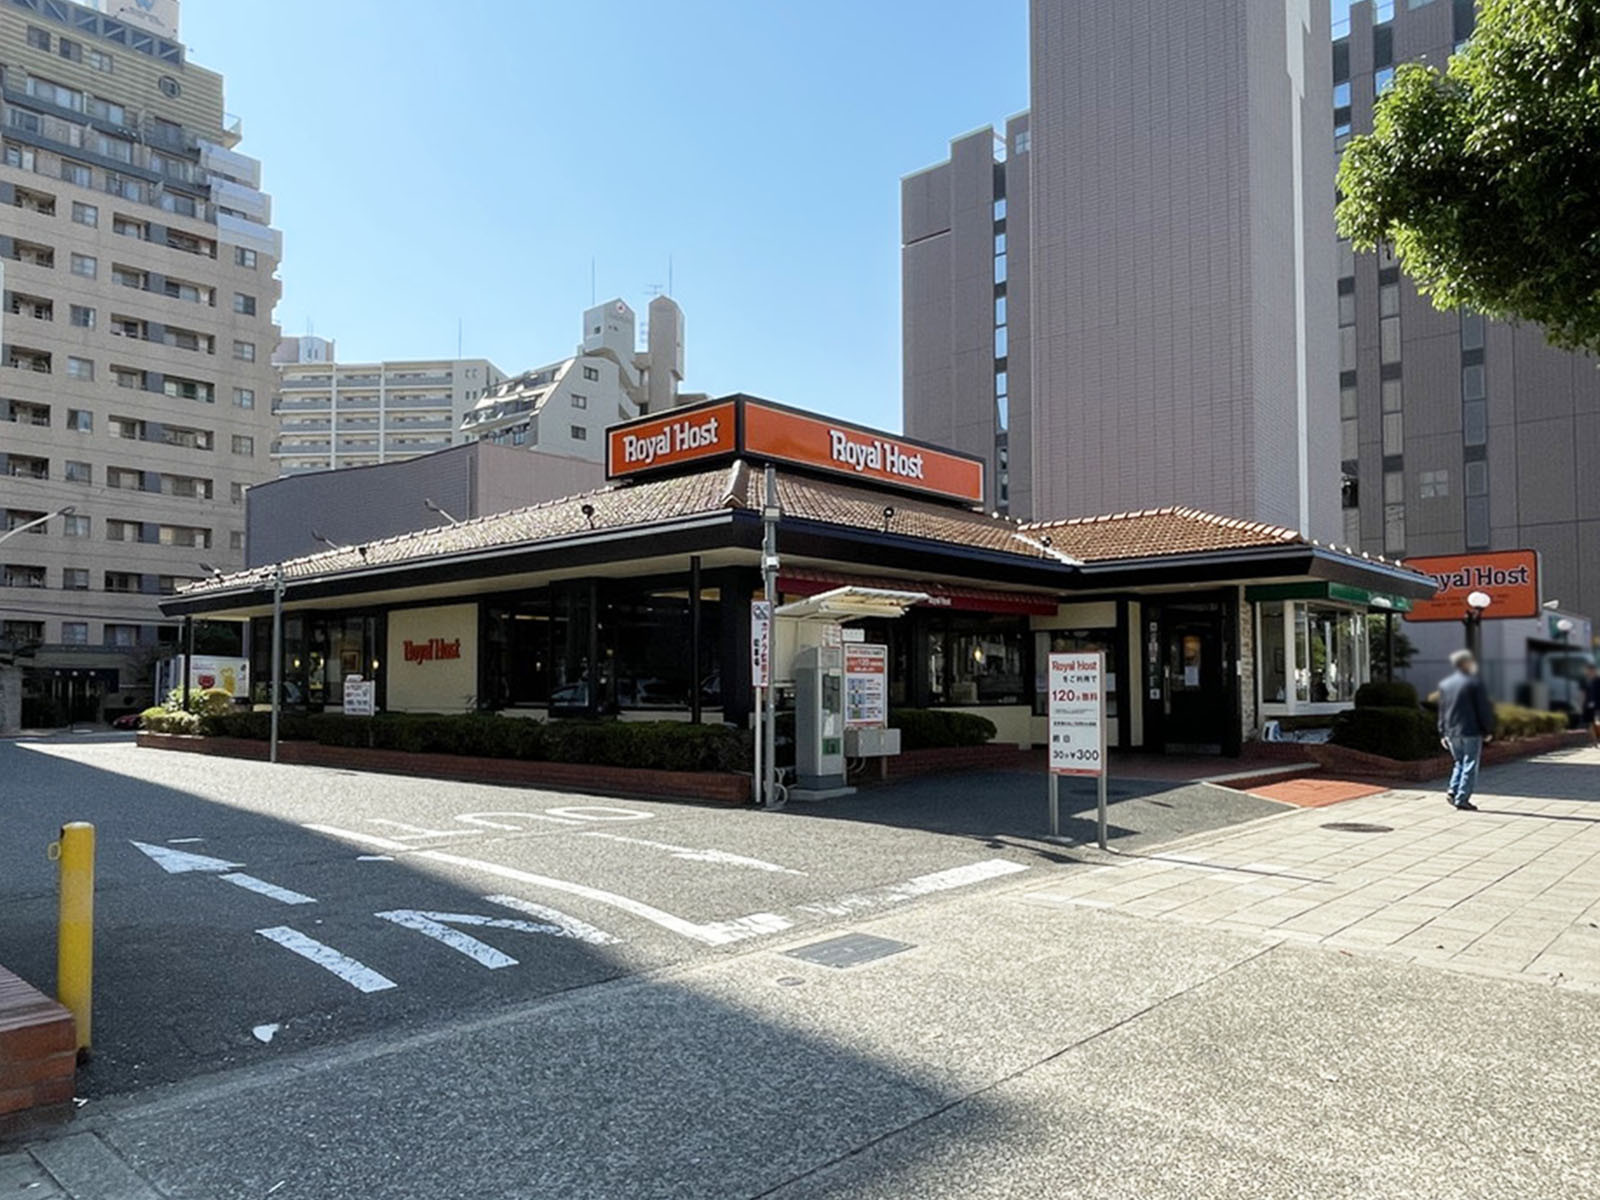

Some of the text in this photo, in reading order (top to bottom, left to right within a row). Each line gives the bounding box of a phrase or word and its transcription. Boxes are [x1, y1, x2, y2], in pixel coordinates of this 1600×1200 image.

[623, 417, 719, 464] Royal Host
[829, 428, 924, 480] Royal Host
[1413, 565, 1529, 592] oyal Host
[1052, 660, 1098, 673] Royal Host
